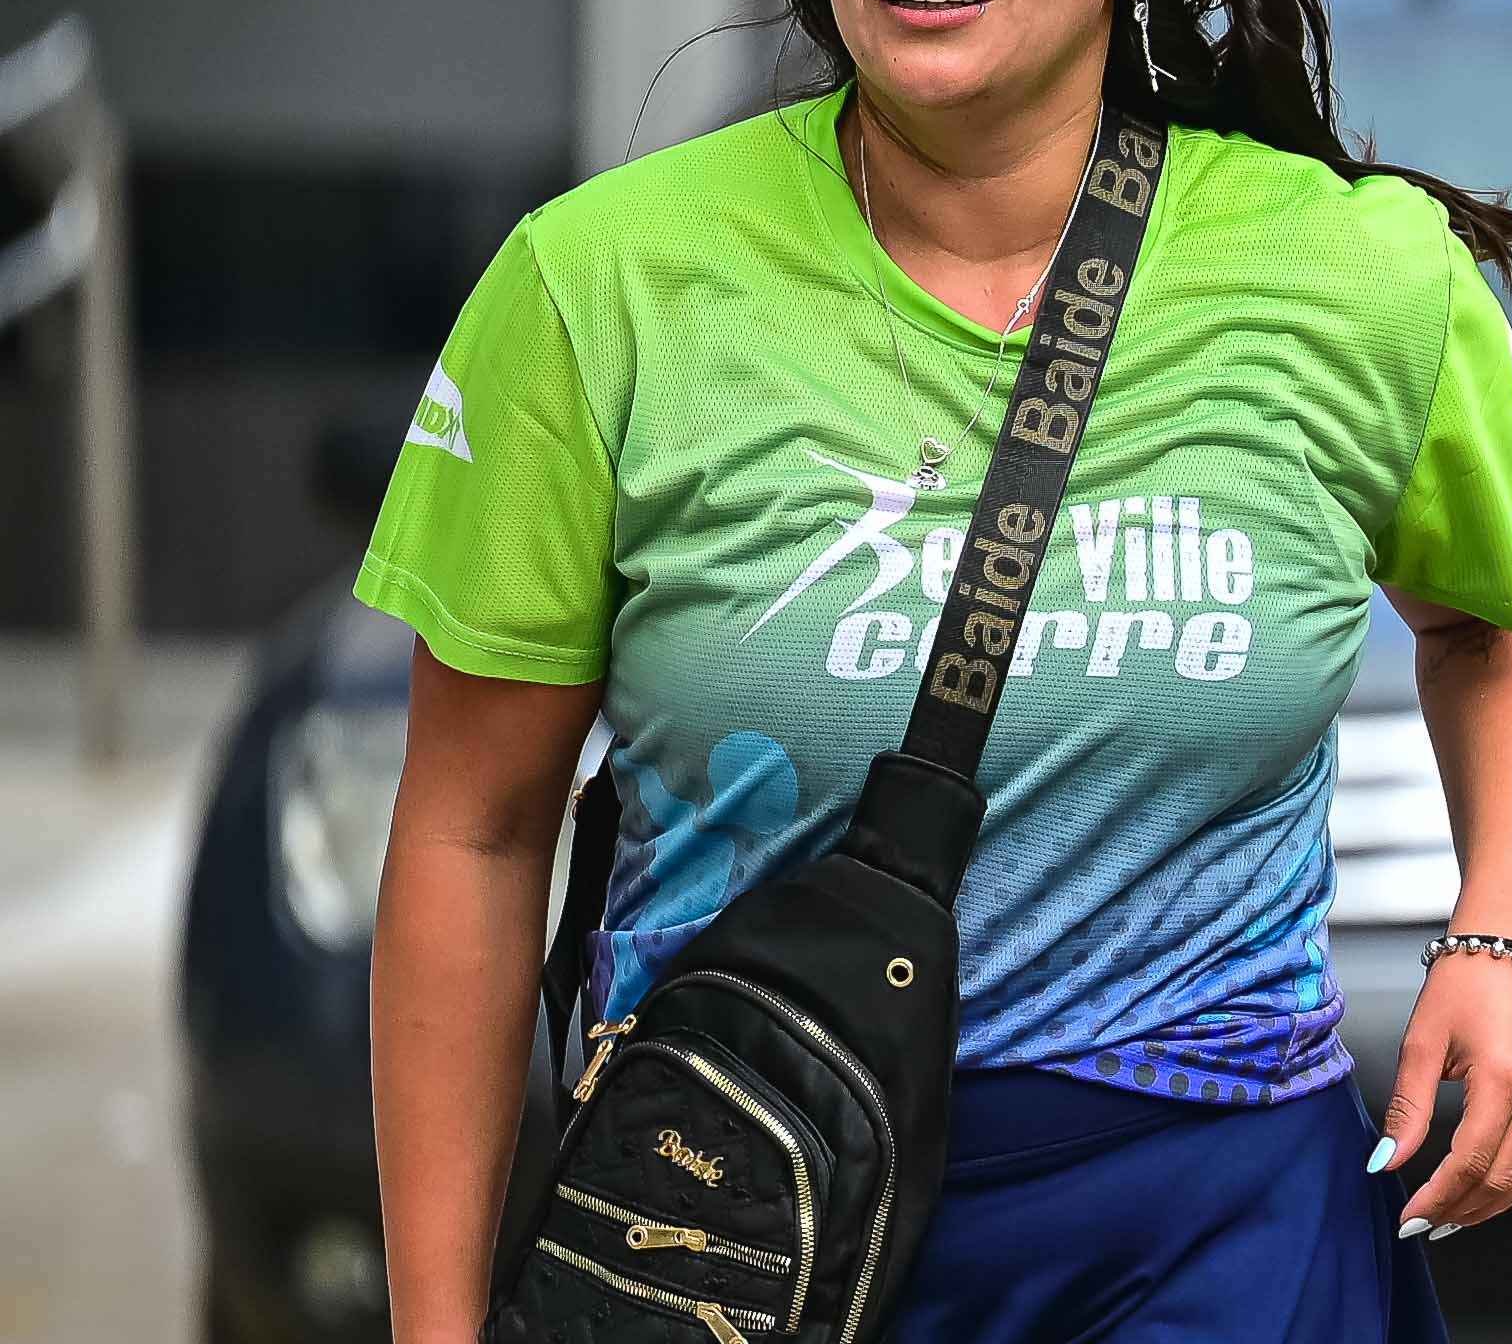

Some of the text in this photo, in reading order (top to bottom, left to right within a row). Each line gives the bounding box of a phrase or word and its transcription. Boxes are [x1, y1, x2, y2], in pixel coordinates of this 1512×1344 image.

[1011, 257, 1124, 454] Baide
[930, 503, 1046, 714] Baide
[1069, 496, 1254, 605] Ville
[824, 609, 1254, 681] crre
